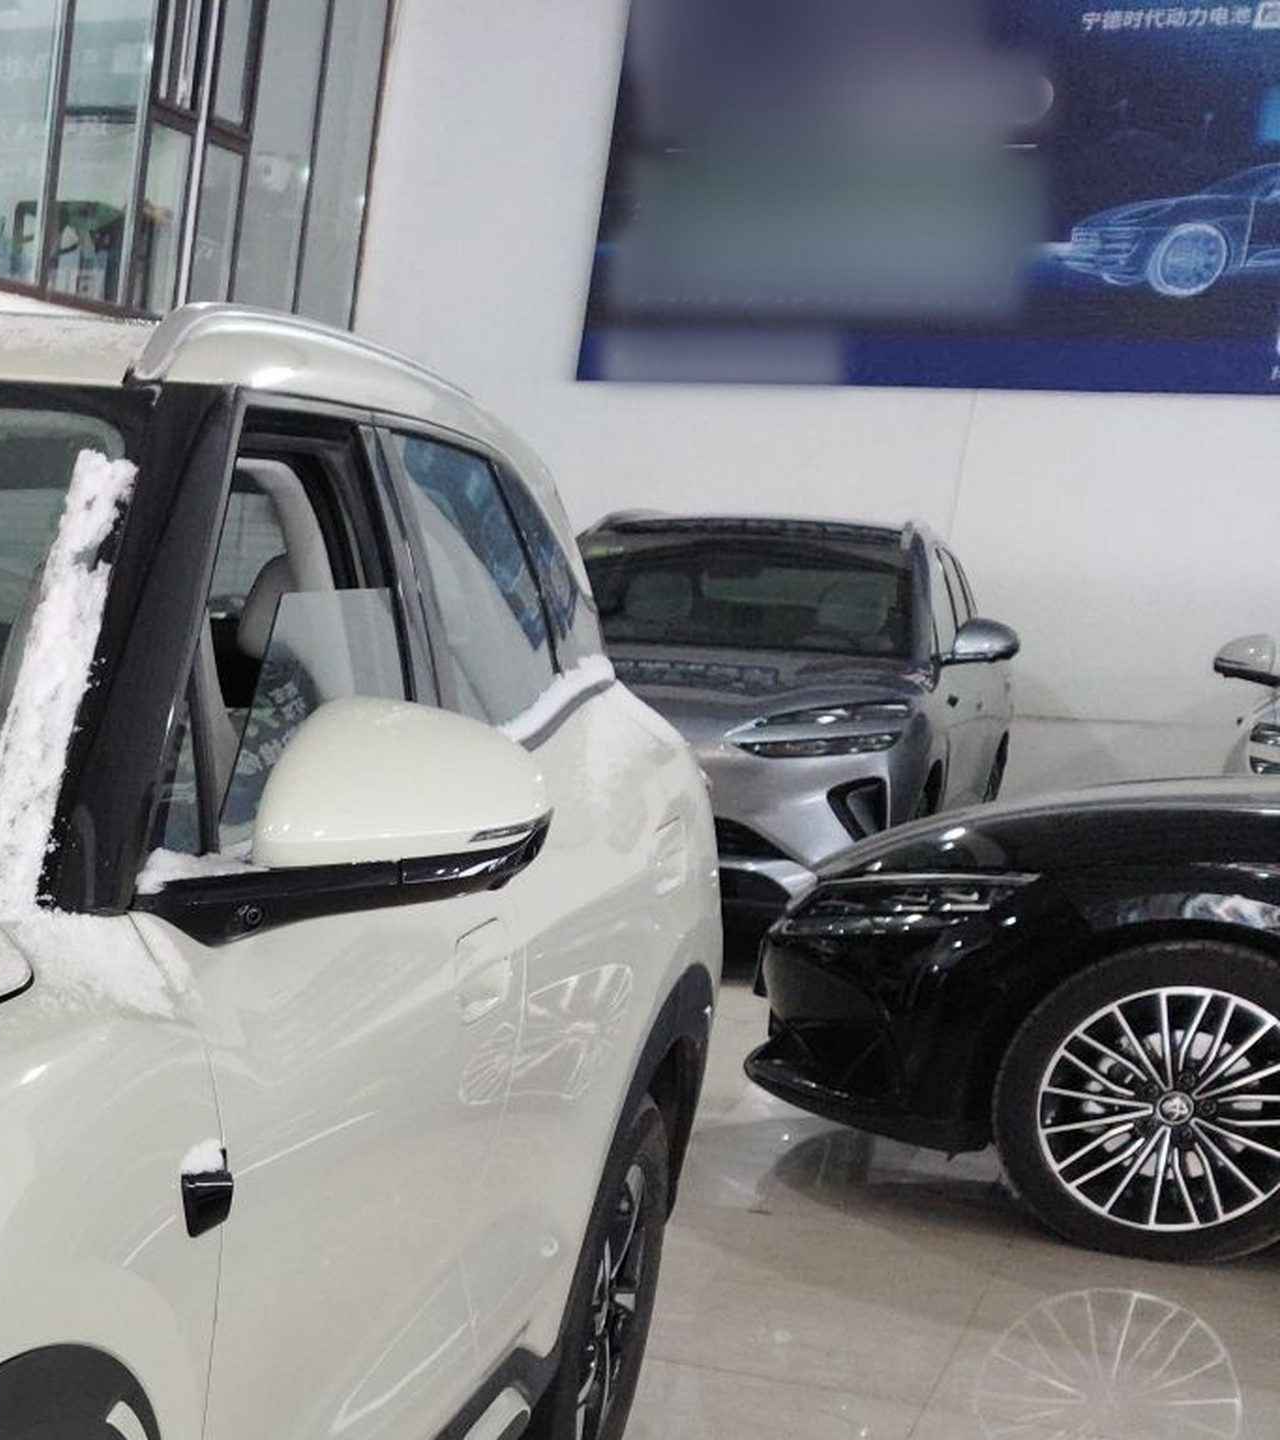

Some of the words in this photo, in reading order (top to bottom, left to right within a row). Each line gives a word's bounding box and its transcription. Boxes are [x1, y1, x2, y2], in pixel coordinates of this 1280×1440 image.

[1082, 6, 1252, 30] 宁德时代动力电池
